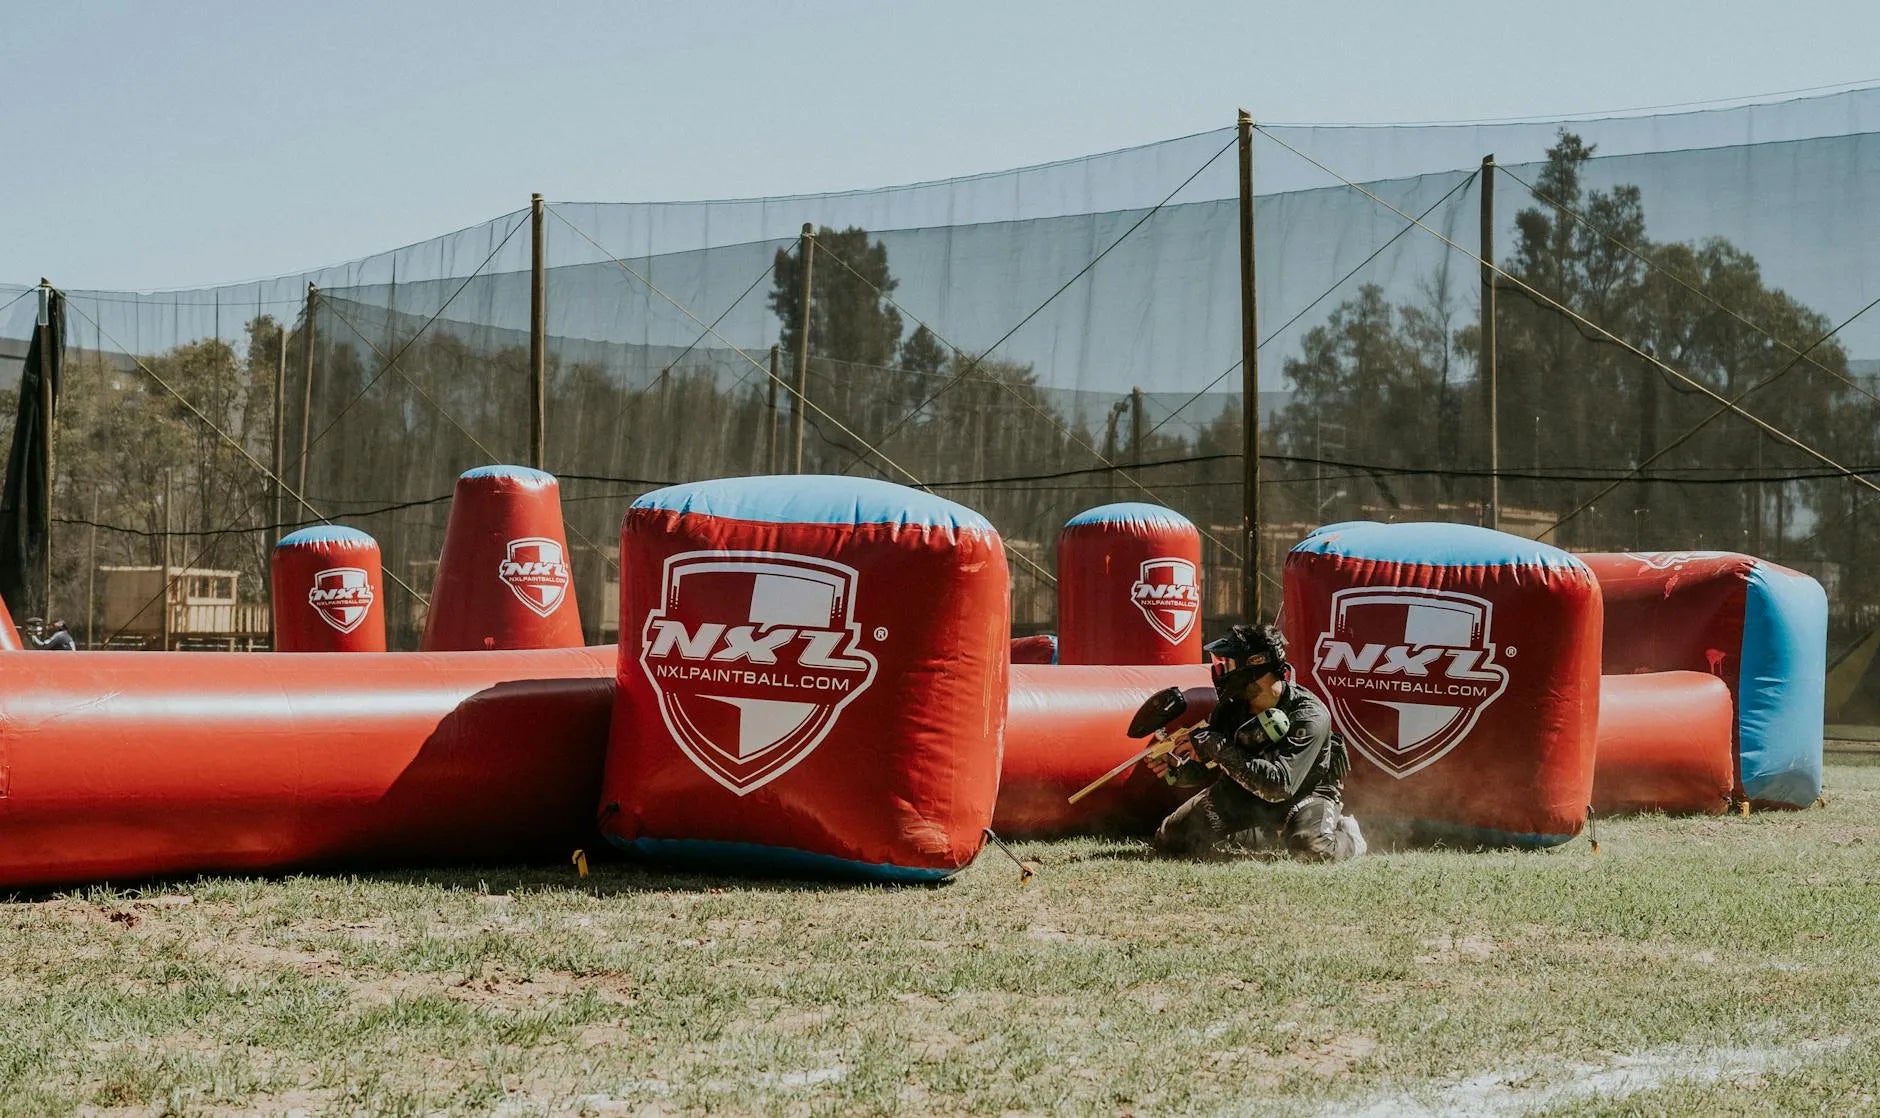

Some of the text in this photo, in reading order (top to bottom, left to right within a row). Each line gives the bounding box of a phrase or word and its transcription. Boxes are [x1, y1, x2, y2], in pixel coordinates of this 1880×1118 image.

[502, 562, 567, 577] NXL
[312, 588, 371, 601] NXL
[1136, 584, 1199, 601] NXL
[649, 619, 868, 671] NXL
[1320, 640, 1501, 682] NXL
[656, 665, 850, 691] NXLPAINTBALL.COM
[1327, 676, 1488, 697] NXLPAINTBALL.COM
